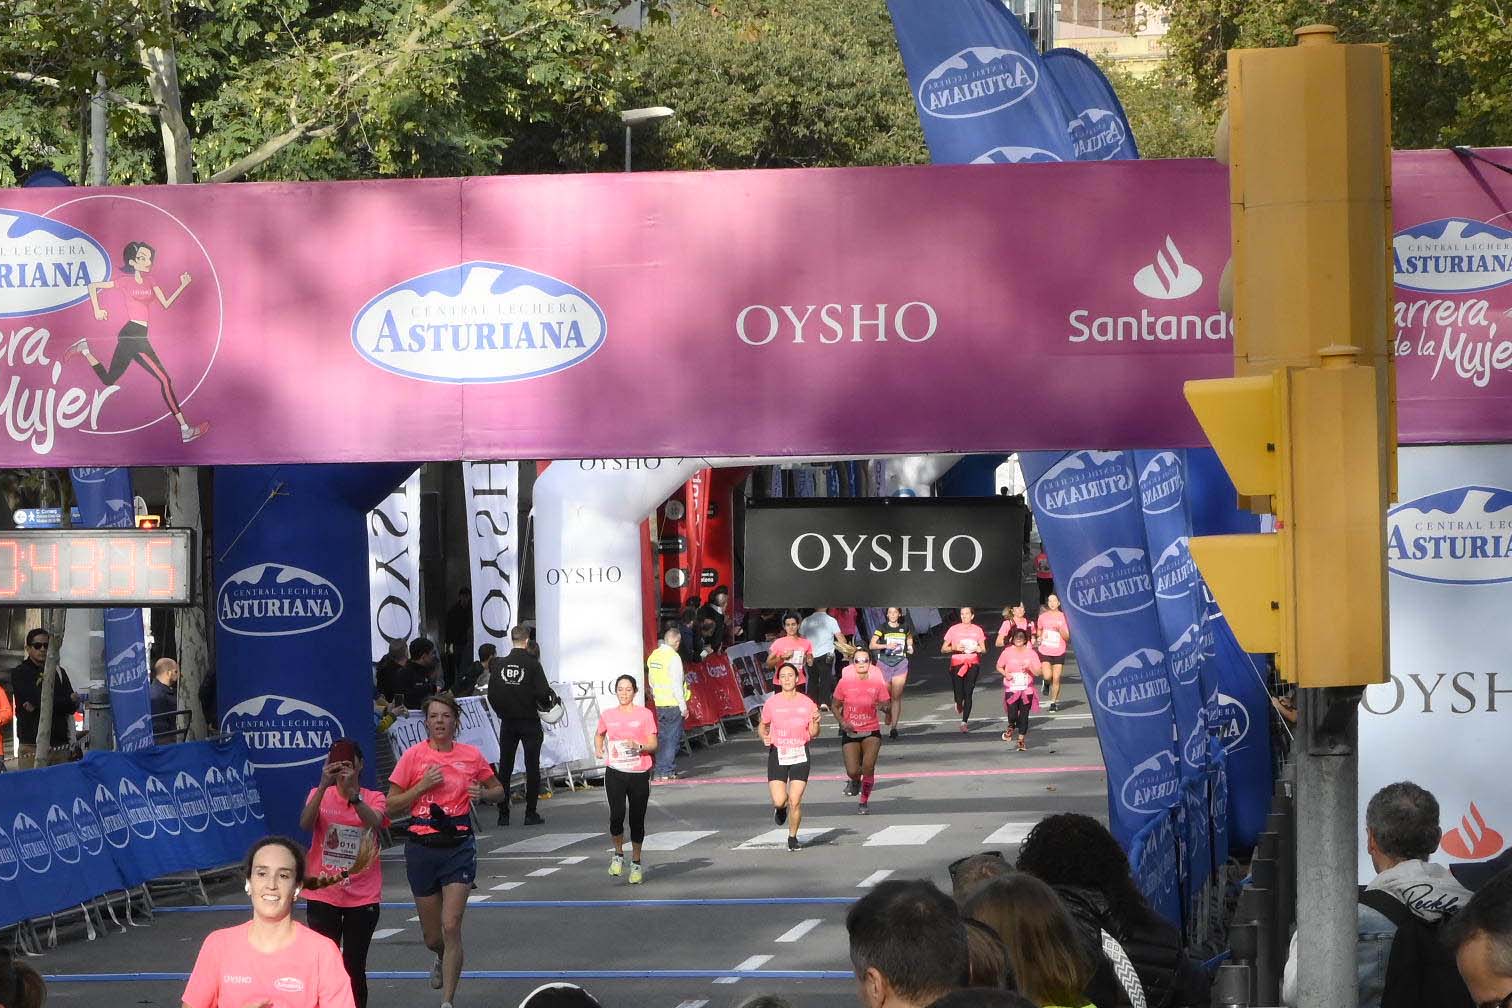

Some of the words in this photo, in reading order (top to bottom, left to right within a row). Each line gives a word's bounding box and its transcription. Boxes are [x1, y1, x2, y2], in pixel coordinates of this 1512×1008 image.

[14, 244, 87, 257] LECHERA
[1464, 242, 1512, 251] LECHER
[736, 301, 938, 346] OYSHO
[1069, 308, 1234, 342] Santand
[1394, 299, 1490, 328] arrera
[372, 309, 587, 353] ASTURIANA
[1417, 329, 1435, 356] la
[1431, 323, 1512, 388] Muje
[1415, 521, 1482, 531] CENTRAL
[791, 533, 983, 574] OYSHO
[1388, 524, 1512, 560] ASTURI
[547, 565, 622, 586] OYSHO
[234, 588, 276, 597] CENTRAL
[281, 587, 329, 596] LECHERA
[221, 593, 334, 620] ASTURIANA
[507, 669, 519, 678] BP
[281, 719, 330, 727] LECHERA
[233, 728, 333, 750] TURIANA
